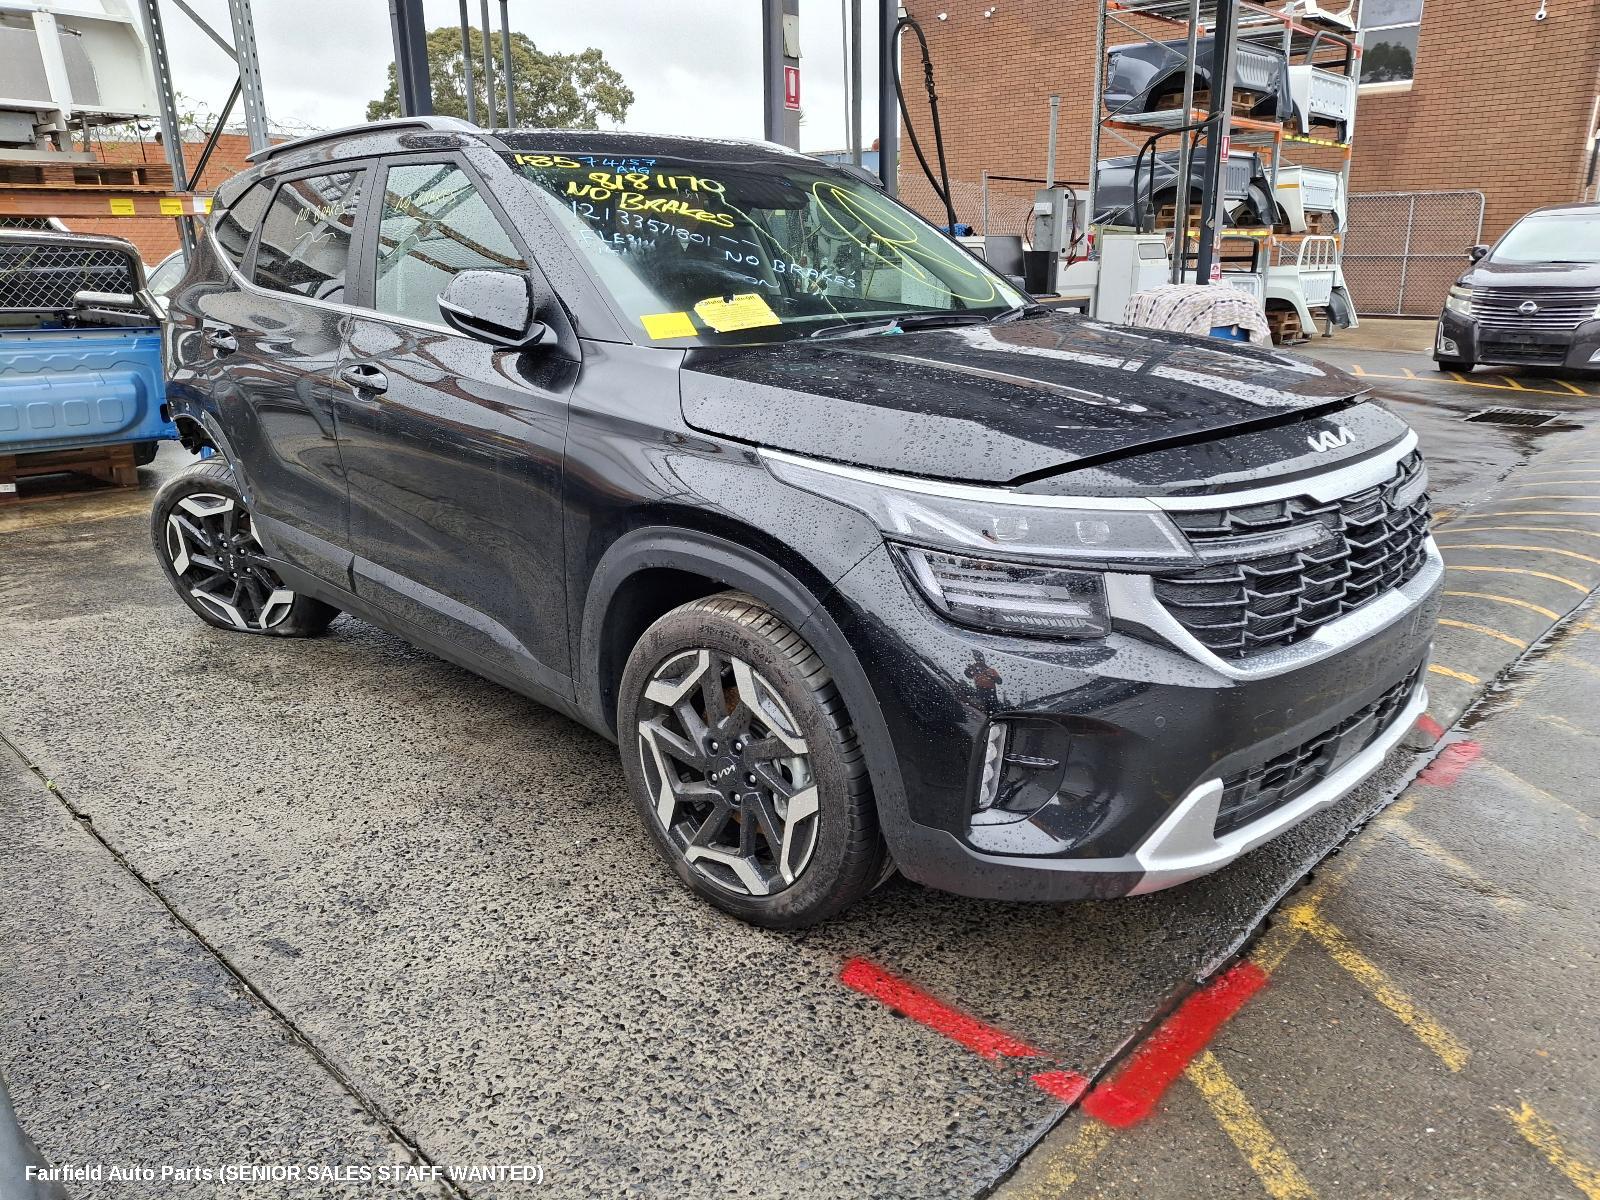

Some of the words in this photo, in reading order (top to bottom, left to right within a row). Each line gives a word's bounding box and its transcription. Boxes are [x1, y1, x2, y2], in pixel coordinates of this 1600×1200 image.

[514, 154, 581, 169] 185
[567, 181, 611, 200] NO
[725, 250, 760, 266] NO
